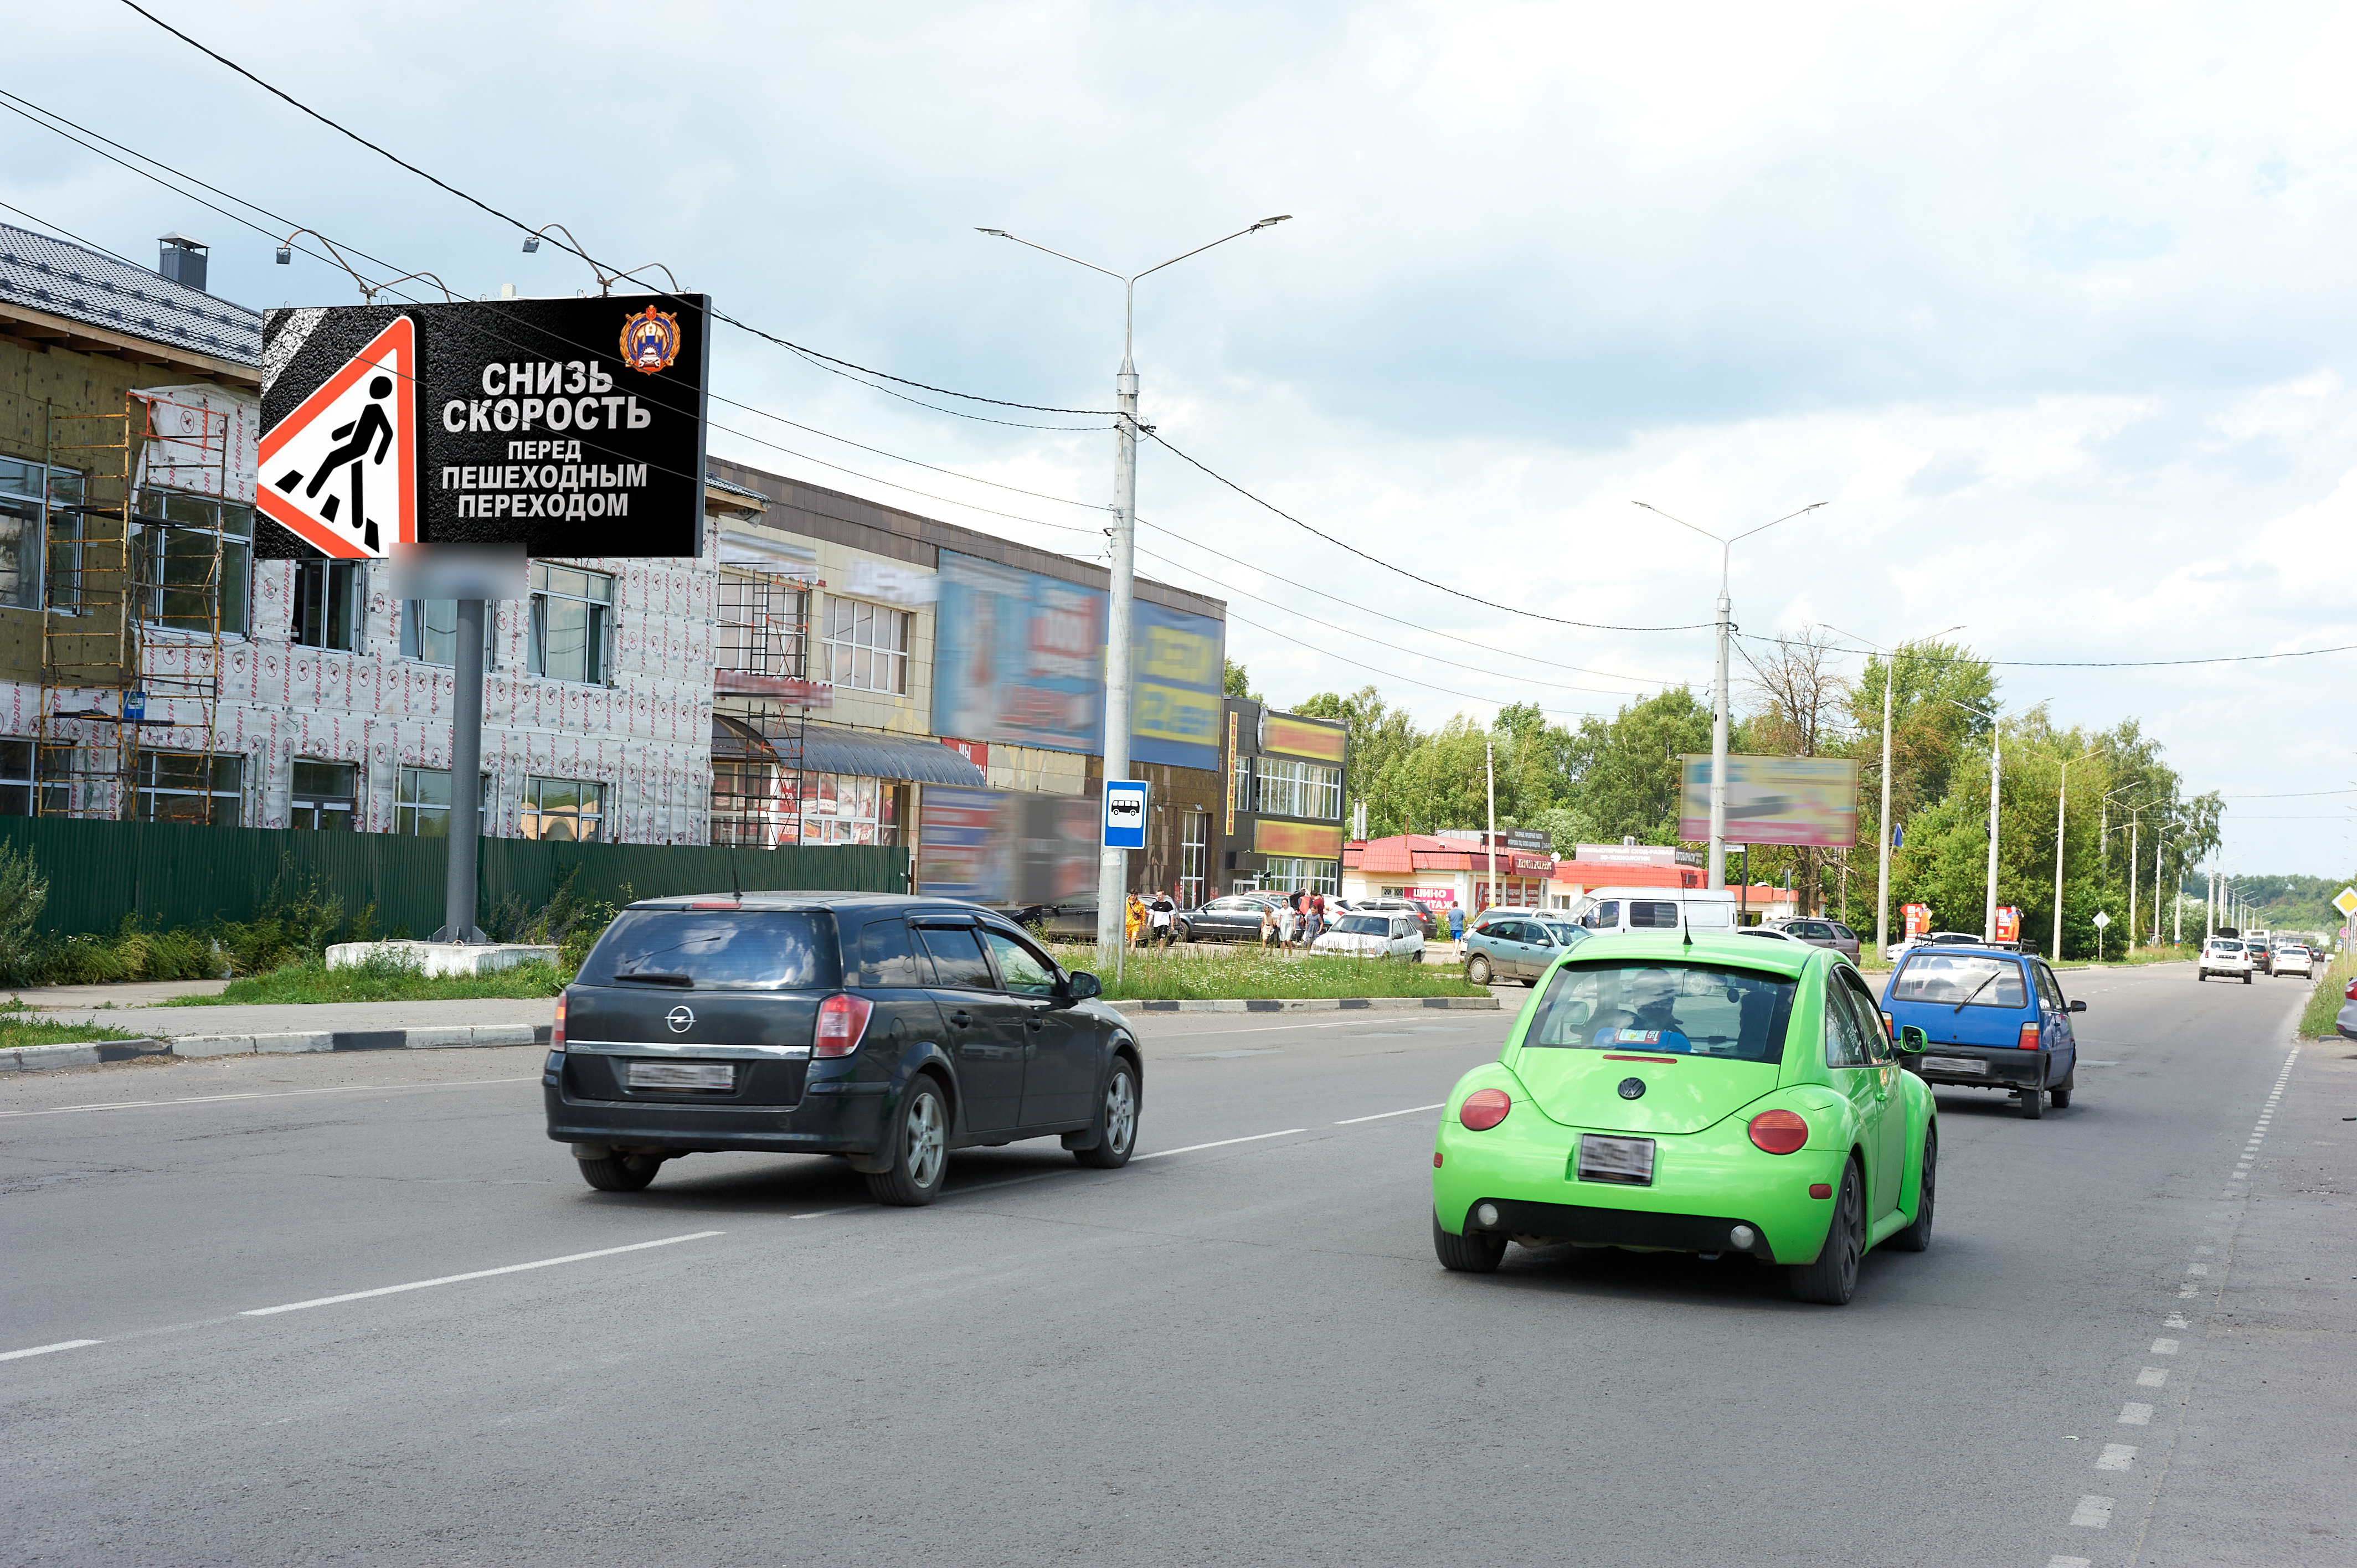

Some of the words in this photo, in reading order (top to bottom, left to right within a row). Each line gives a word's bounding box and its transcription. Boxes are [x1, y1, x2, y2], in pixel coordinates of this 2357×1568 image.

[482, 360, 613, 396] СНИЗЬ
[443, 396, 651, 432] СКОРОСТЬ
[235, 421, 243, 470] ИЗОСПАН
[508, 441, 581, 462] ПЕРЕД
[442, 463, 647, 492] ПЕШЕХОДНЫМ
[458, 493, 628, 522] ПЕРЕХОДОМ
[959, 744, 971, 760] МЫ
[1413, 889, 1447, 898] ШИНО
[1413, 899, 1454, 909] НТАЖ
